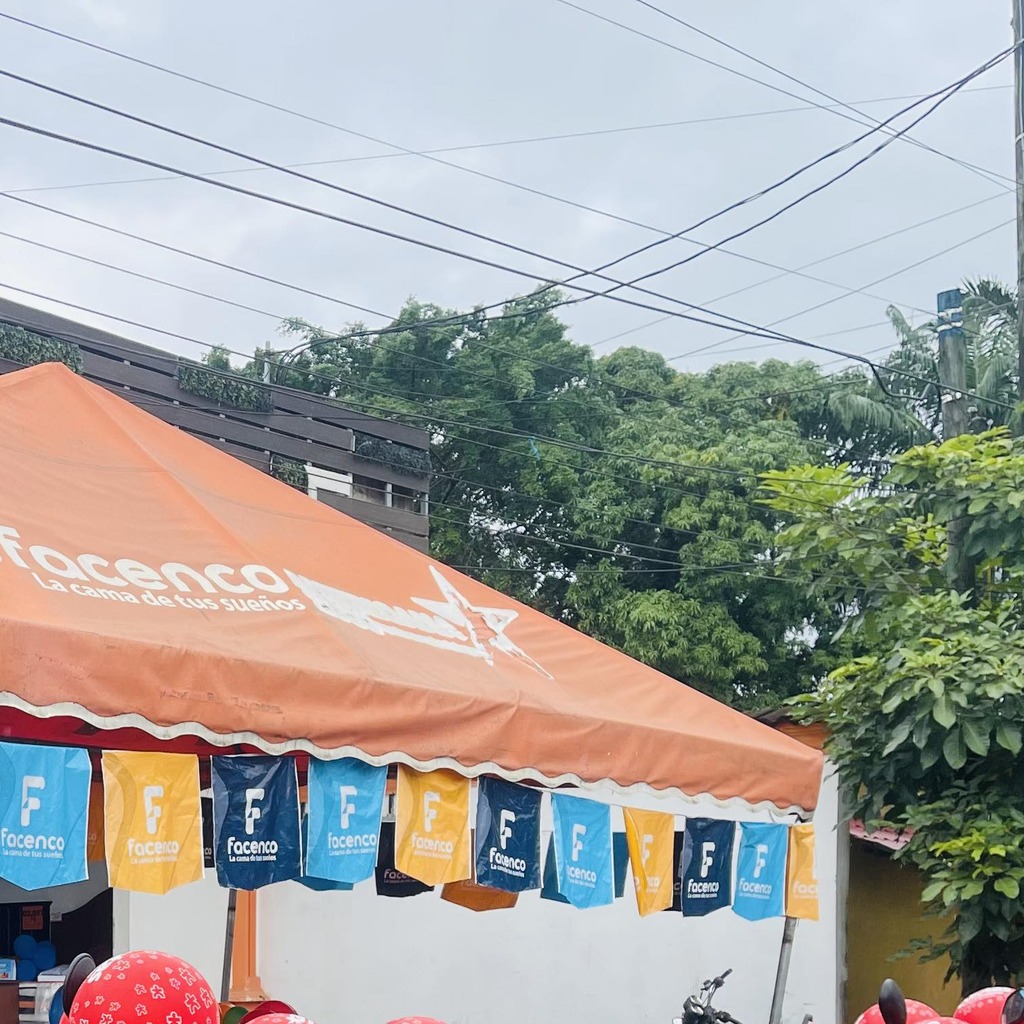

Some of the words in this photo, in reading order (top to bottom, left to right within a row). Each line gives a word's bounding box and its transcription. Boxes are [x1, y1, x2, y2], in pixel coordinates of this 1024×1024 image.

[31, 572, 67, 593] La
[70, 583, 142, 605] cama
[141, 590, 176, 608] de
[176, 594, 219, 611] tus
[219, 594, 306, 612] sueños
[20, 775, 46, 827] F
[143, 785, 164, 835] F
[244, 788, 265, 835] F
[339, 785, 358, 830] F
[1, 828, 65, 851] facenco
[127, 838, 180, 857] facenco
[227, 836, 278, 855] facenco
[328, 832, 377, 849] facenco
[489, 847, 526, 871] facenco
[687, 879, 720, 894] facenco
